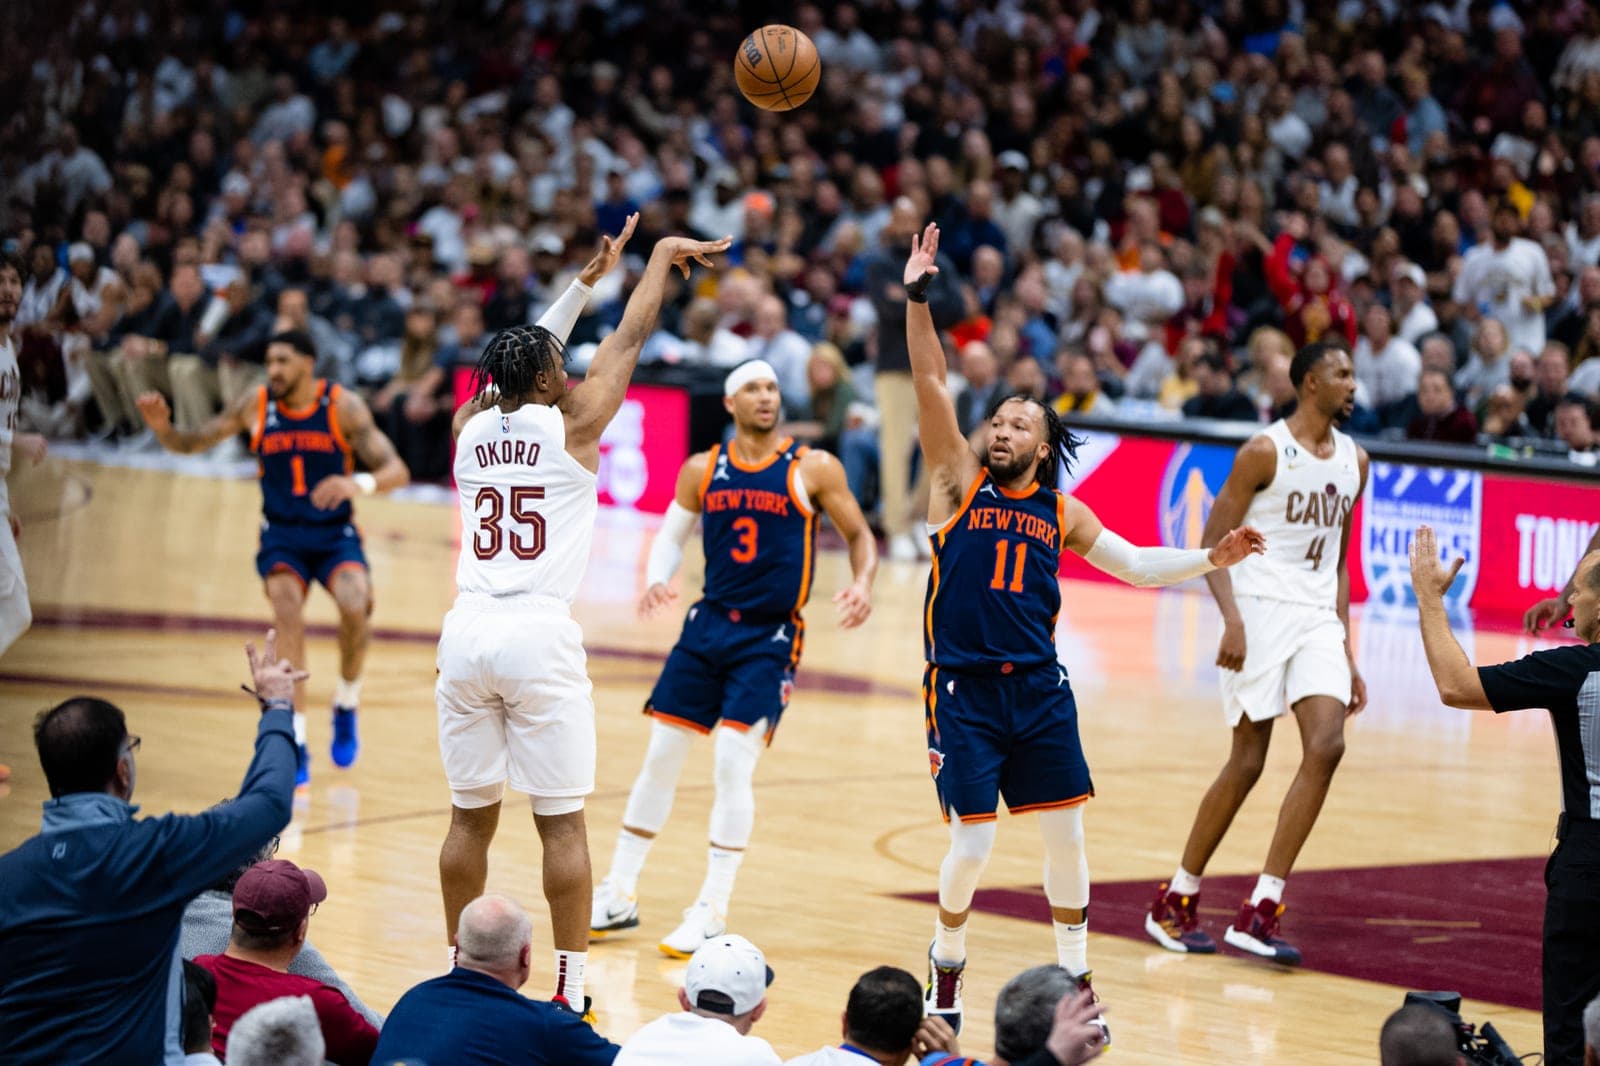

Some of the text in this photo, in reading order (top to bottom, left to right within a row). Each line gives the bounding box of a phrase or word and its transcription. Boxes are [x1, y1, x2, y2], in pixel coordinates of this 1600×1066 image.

[262, 430, 335, 455] NEW YORK
[475, 440, 541, 468] OKORO
[290, 455, 308, 496] 1
[706, 489, 789, 517] NEW YORK
[1286, 491, 1352, 528] CAVS
[473, 486, 547, 560] 35
[730, 516, 758, 564] 3
[967, 507, 1057, 550] NEW YORK
[990, 539, 1028, 593] 11
[1304, 536, 1326, 571] 4
